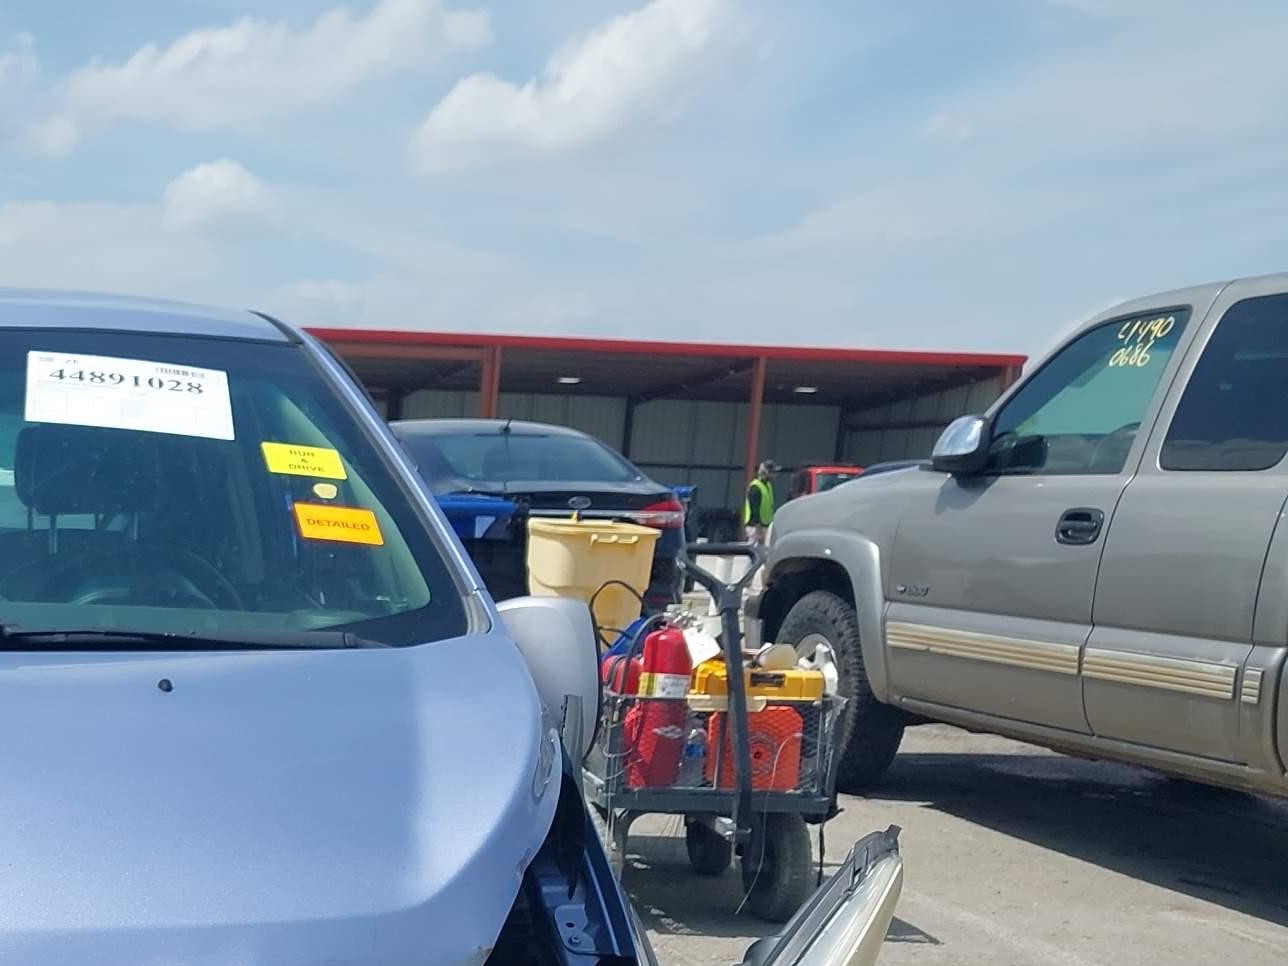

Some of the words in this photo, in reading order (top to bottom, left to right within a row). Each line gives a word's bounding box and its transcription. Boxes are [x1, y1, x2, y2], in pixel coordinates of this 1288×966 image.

[1108, 340, 1155, 367] 0686
[48, 367, 205, 395] 44891028
[289, 463, 326, 473] DRIVE
[306, 518, 370, 531] DETAILED
